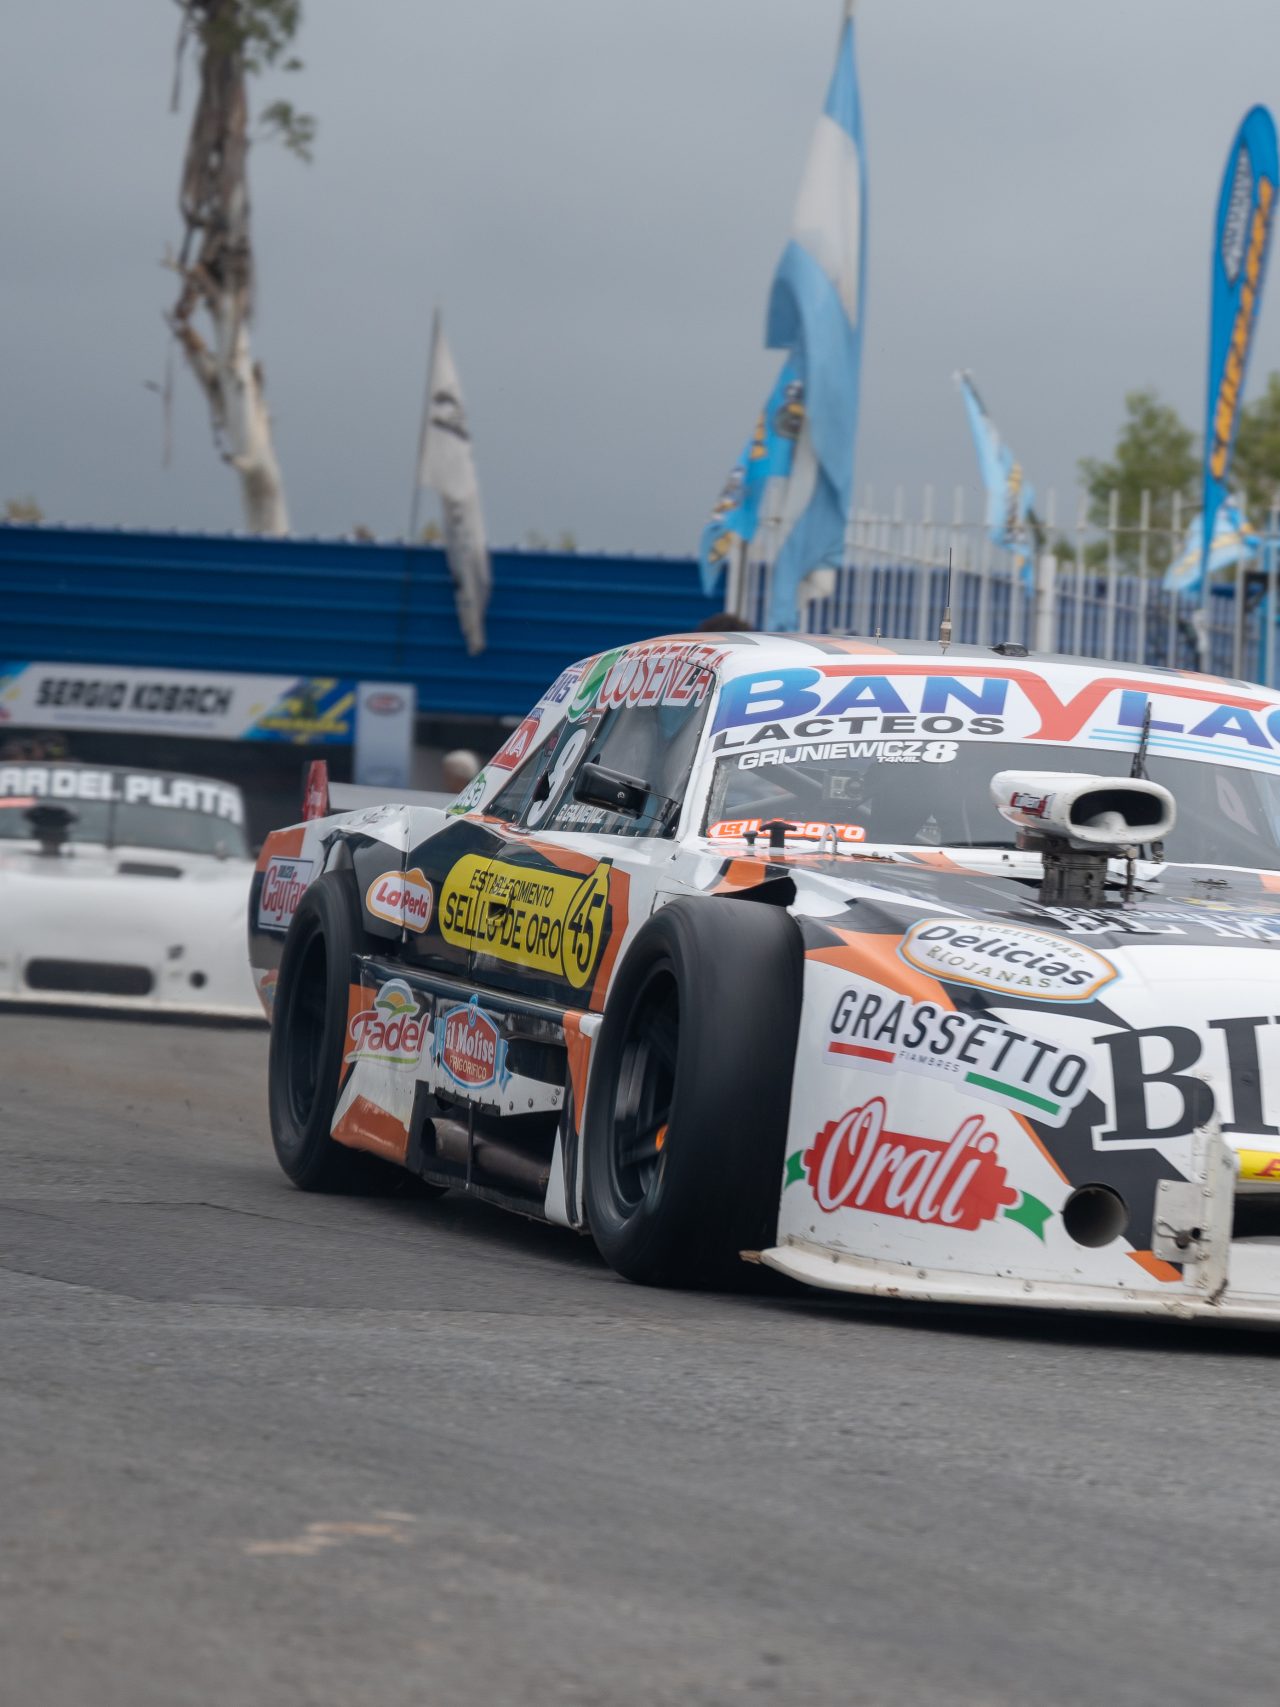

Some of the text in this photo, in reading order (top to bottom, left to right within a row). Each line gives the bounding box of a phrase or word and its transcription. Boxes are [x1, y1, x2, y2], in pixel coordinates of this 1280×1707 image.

[35, 678, 126, 709] SERGIO
[599, 644, 733, 704] COSENZA
[713, 714, 1006, 751] LACTEOS
[738, 740, 960, 771] GRIJNIEWICZ 8
[0, 766, 244, 824] AR DEL PLATA
[375, 881, 401, 908] La
[500, 906, 526, 950] DE
[525, 912, 561, 960] ORO
[567, 877, 606, 973] 45
[972, 924, 1082, 959] ACEITUNAS
[917, 925, 1094, 985] Delicias
[926, 944, 1052, 989] RIOJANAS
[351, 1010, 430, 1054] Fadel
[457, 1022, 495, 1065] Molise
[830, 989, 1088, 1098] GRASSETTO
[899, 1050, 961, 1073] FIAMBRES
